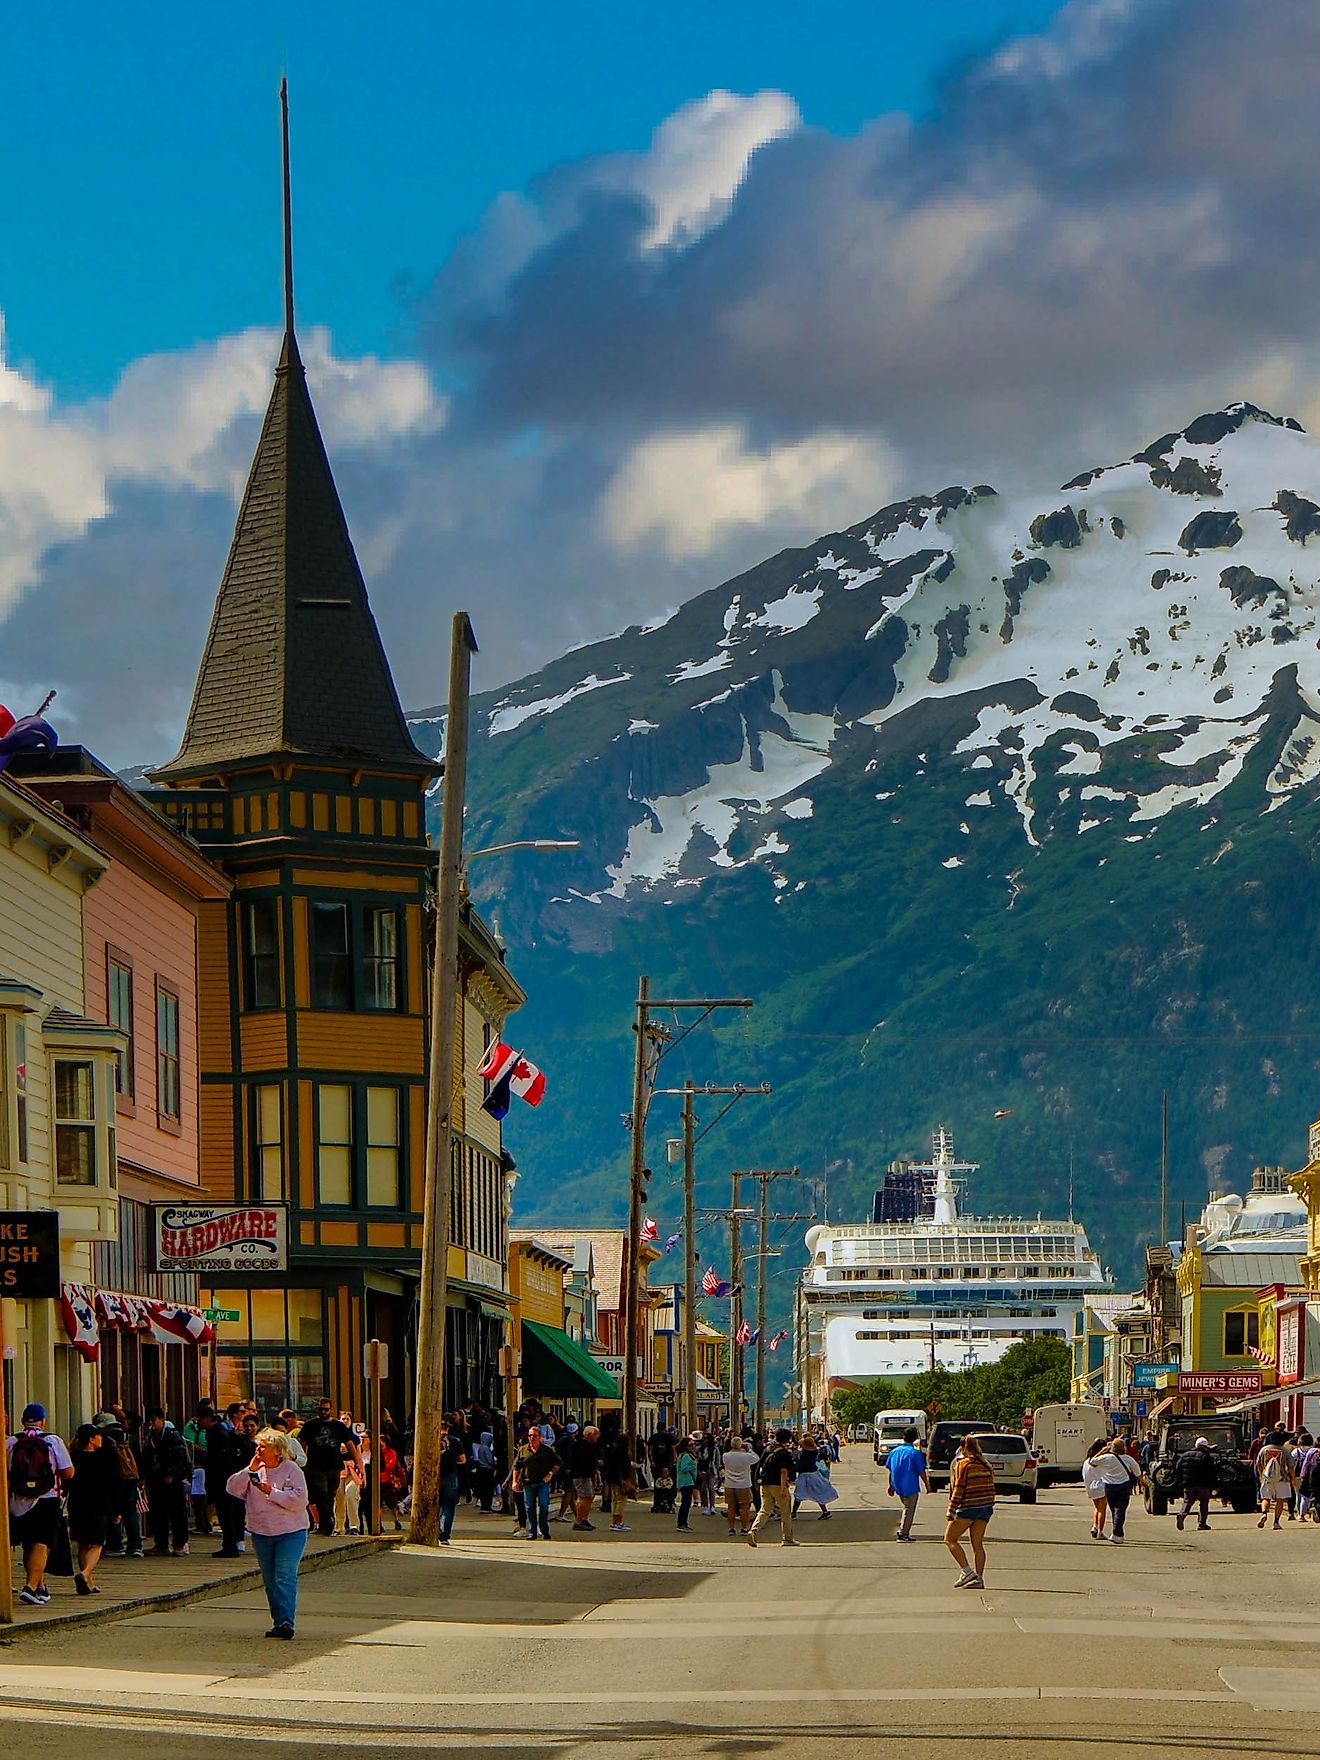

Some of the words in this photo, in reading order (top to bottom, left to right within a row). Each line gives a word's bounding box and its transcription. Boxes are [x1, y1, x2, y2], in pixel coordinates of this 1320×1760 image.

[161, 1211, 277, 1257] HARDWARE
[240, 1244, 259, 1254] CO.
[160, 1259, 231, 1270] SPORTING
[233, 1259, 279, 1270] GOODS
[216, 1311, 230, 1320] AVE
[1142, 1367, 1170, 1375] EMPIRE
[1182, 1376, 1226, 1389] MINER'S
[1228, 1376, 1259, 1389] GEMS
